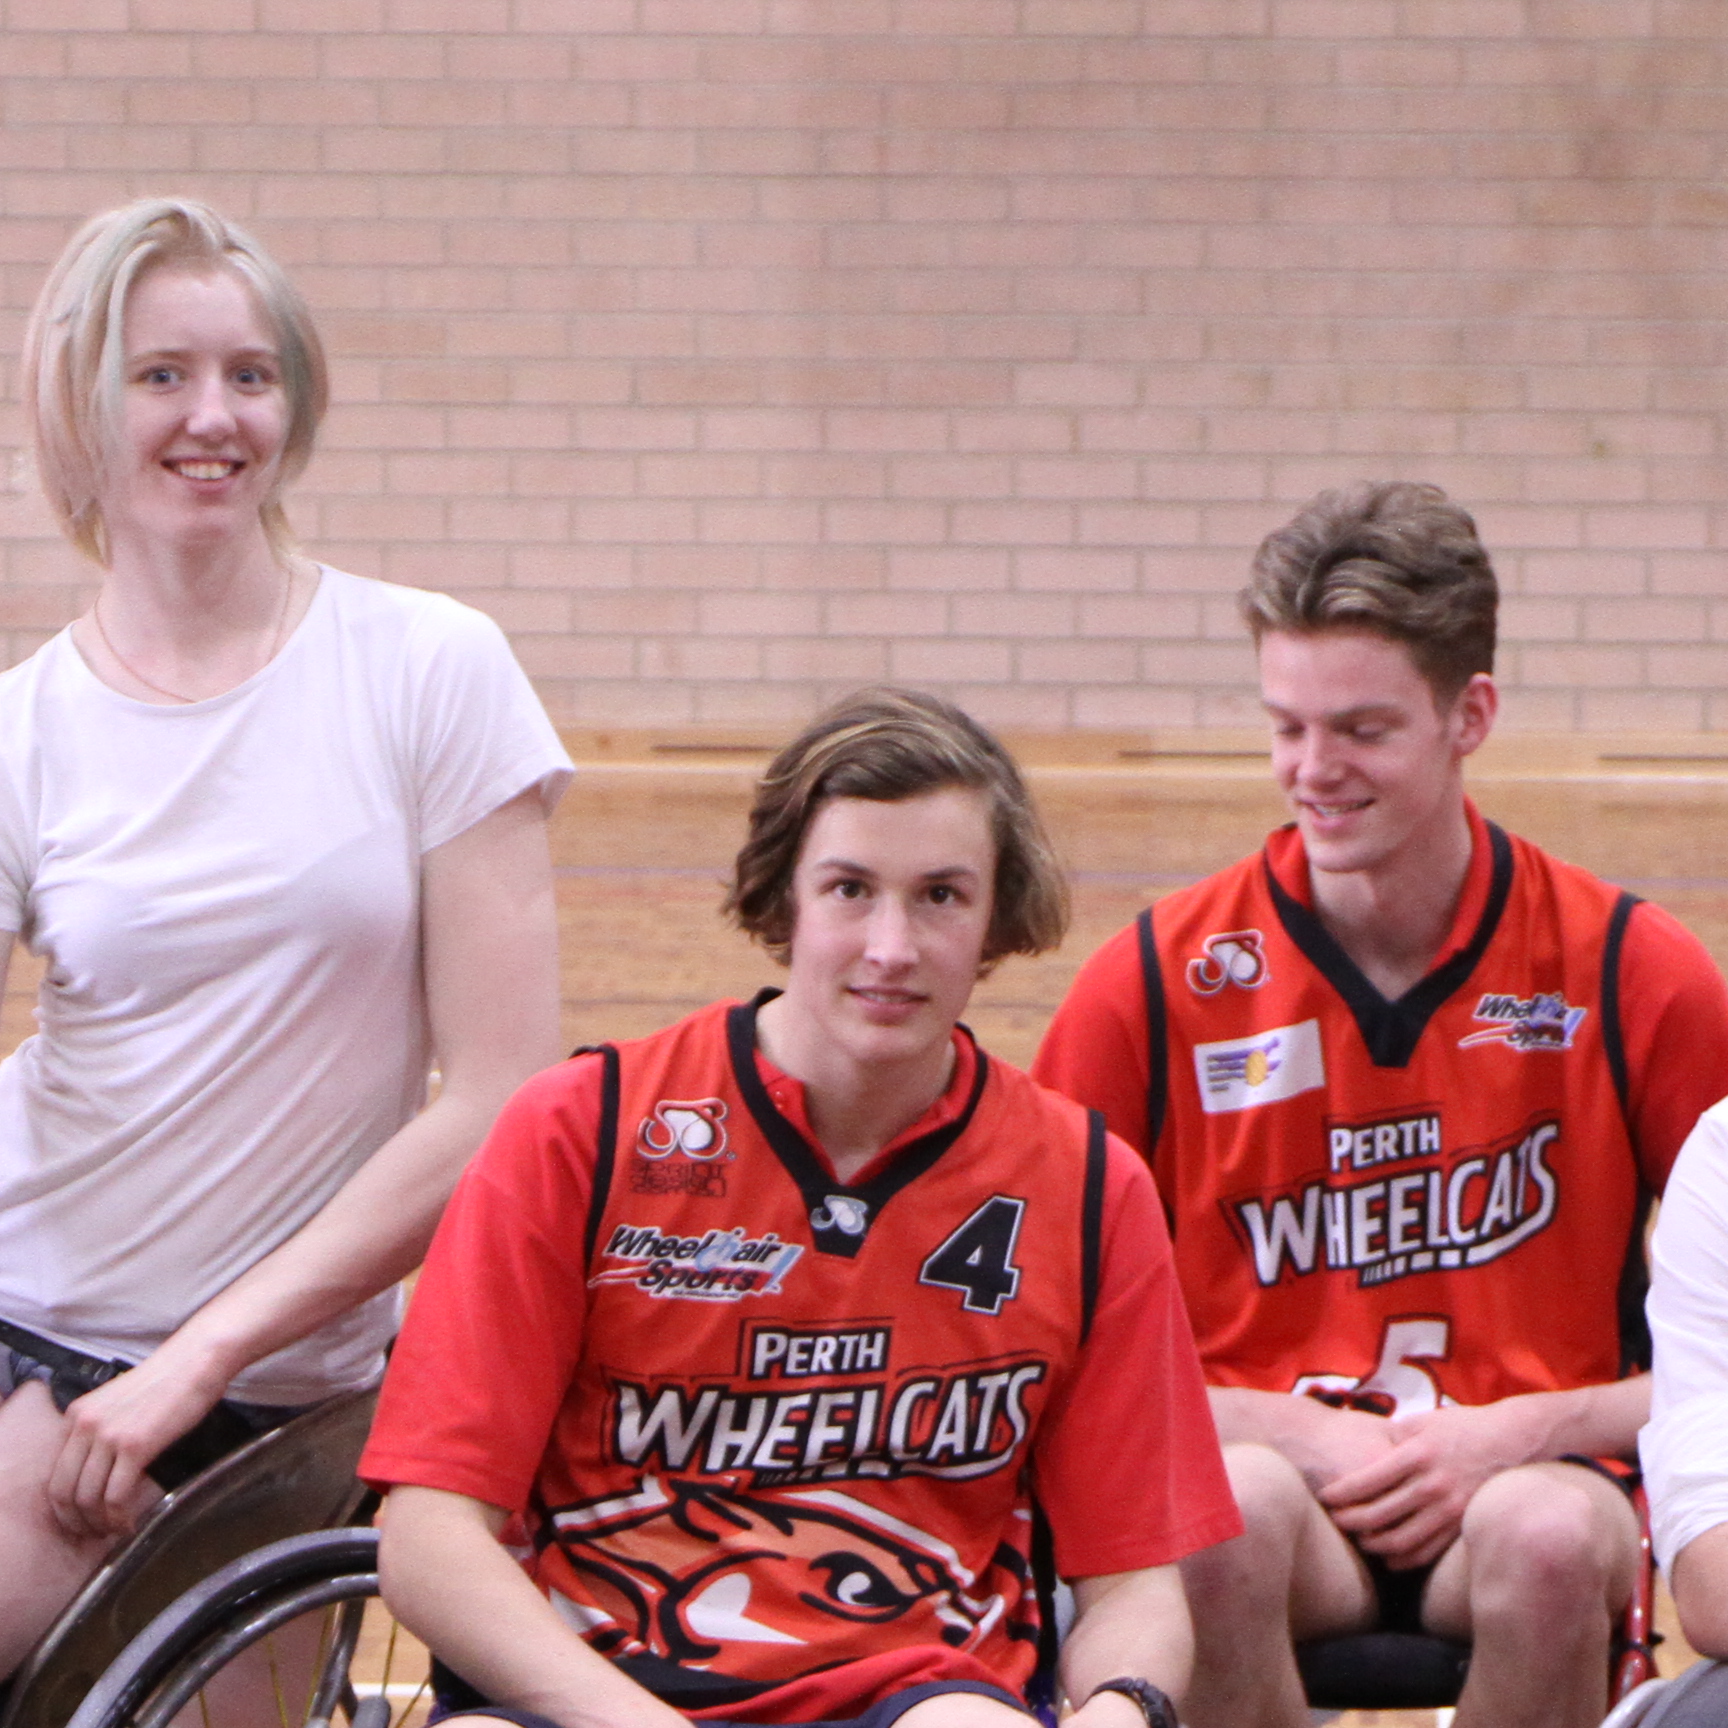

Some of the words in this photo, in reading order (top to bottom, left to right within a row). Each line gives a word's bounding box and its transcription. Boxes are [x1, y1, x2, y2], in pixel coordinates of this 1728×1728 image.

[1330, 1116, 1440, 1174] PERTH
[1242, 1124, 1559, 1286] WHEELCATS
[640, 1259, 760, 1294] Sports
[920, 1194, 1027, 1315] 4
[752, 1330, 886, 1376] PERTH
[617, 1364, 1042, 1474] WHEELCATS
